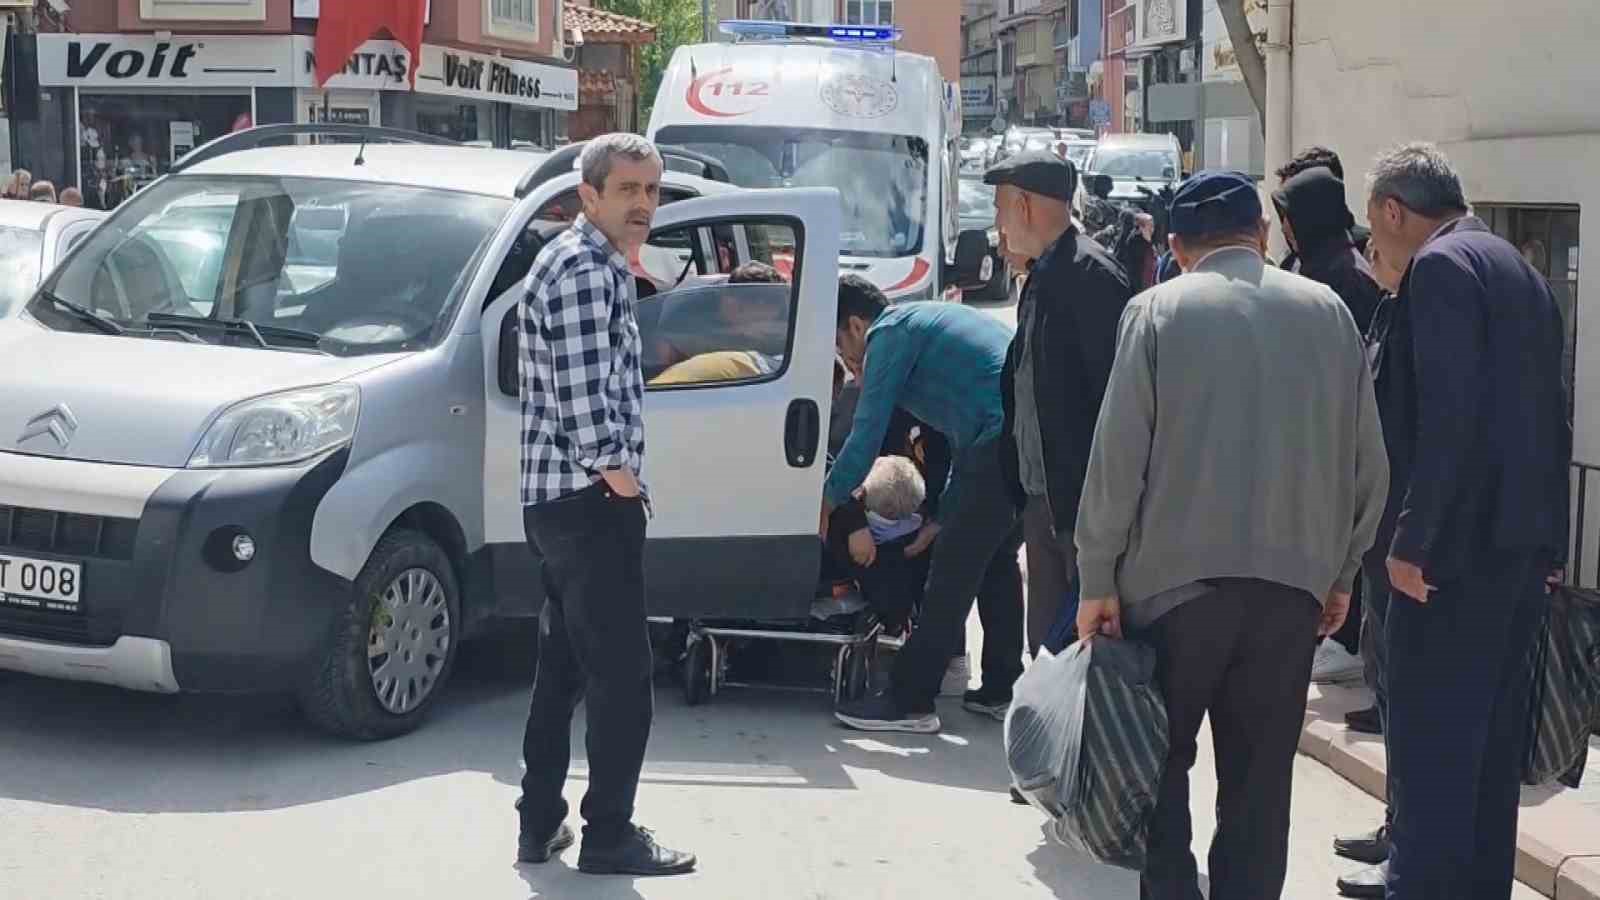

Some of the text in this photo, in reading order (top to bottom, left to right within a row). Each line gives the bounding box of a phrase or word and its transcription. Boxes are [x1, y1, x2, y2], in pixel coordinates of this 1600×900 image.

[66, 42, 197, 78] Voit
[305, 50, 407, 82] NTAŞ
[443, 52, 541, 99] Voit Fitness
[706, 81, 769, 96] 112
[21, 563, 75, 596] 008
